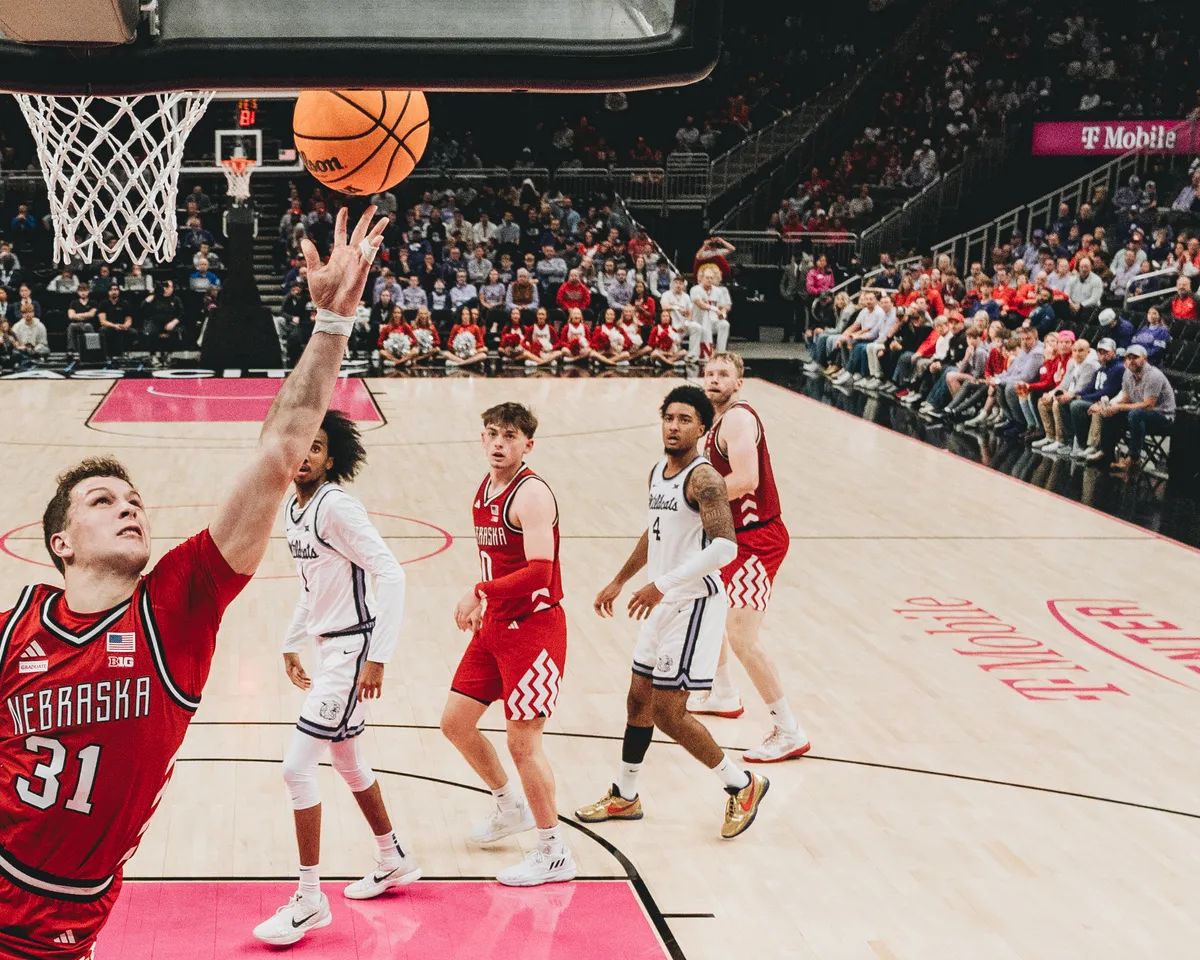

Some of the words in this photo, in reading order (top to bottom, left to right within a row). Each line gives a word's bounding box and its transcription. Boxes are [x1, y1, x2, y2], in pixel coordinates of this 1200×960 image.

[1103, 125, 1176, 149] Mobile
[652, 516, 661, 541] 4
[20, 663, 47, 671] GRADUATE
[6, 676, 151, 737] NEBRASKA
[14, 733, 103, 816] 31
